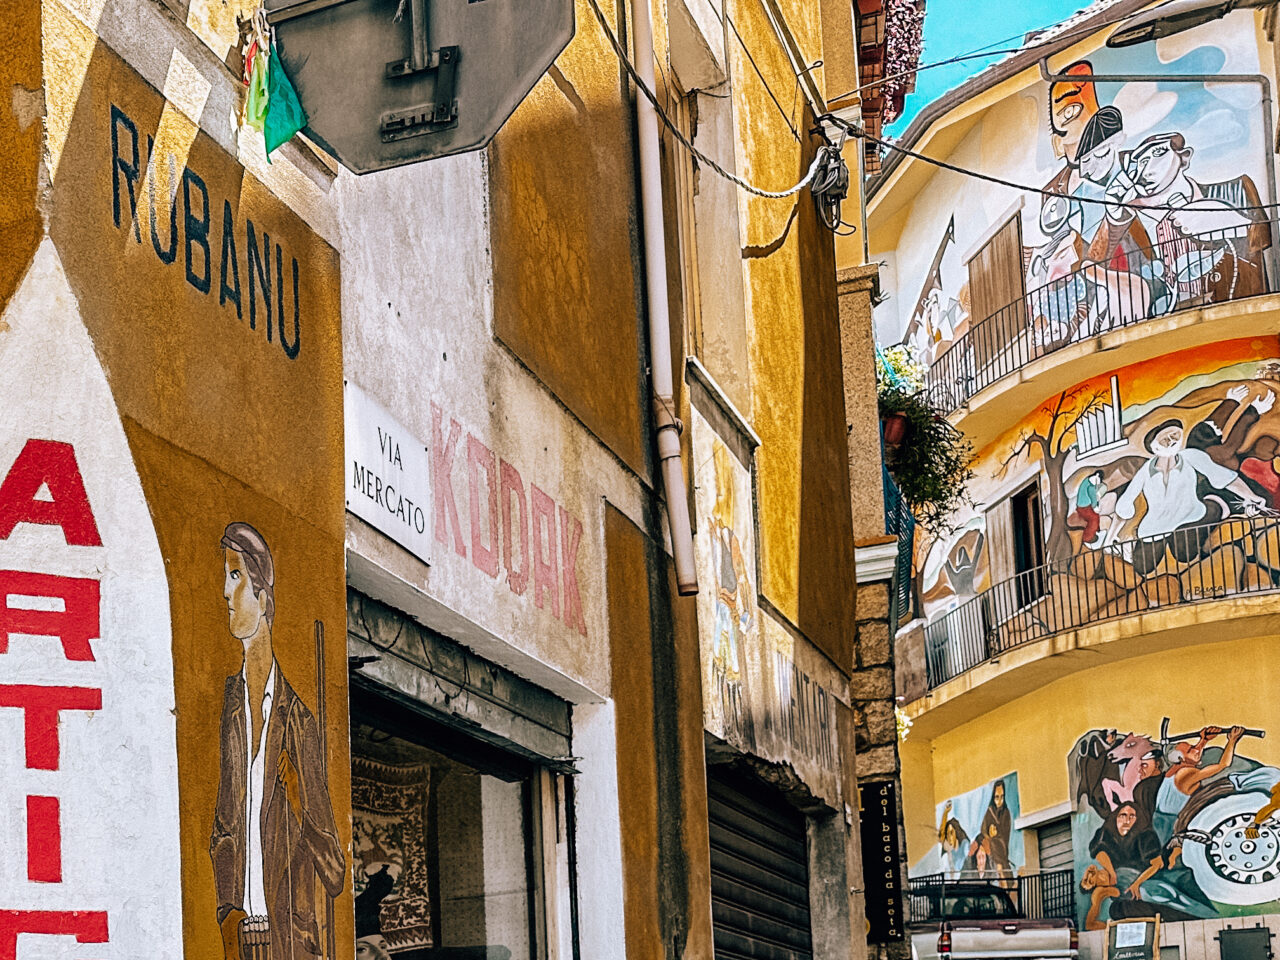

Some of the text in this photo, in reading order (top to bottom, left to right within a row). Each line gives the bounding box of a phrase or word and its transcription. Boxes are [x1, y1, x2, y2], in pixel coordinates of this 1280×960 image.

[110, 103, 301, 361] RUBANU
[352, 461, 426, 535] MERCATO
[377, 427, 404, 472] VIA
[429, 399, 588, 638] KODAK
[879, 786, 897, 936] del baco da seta
